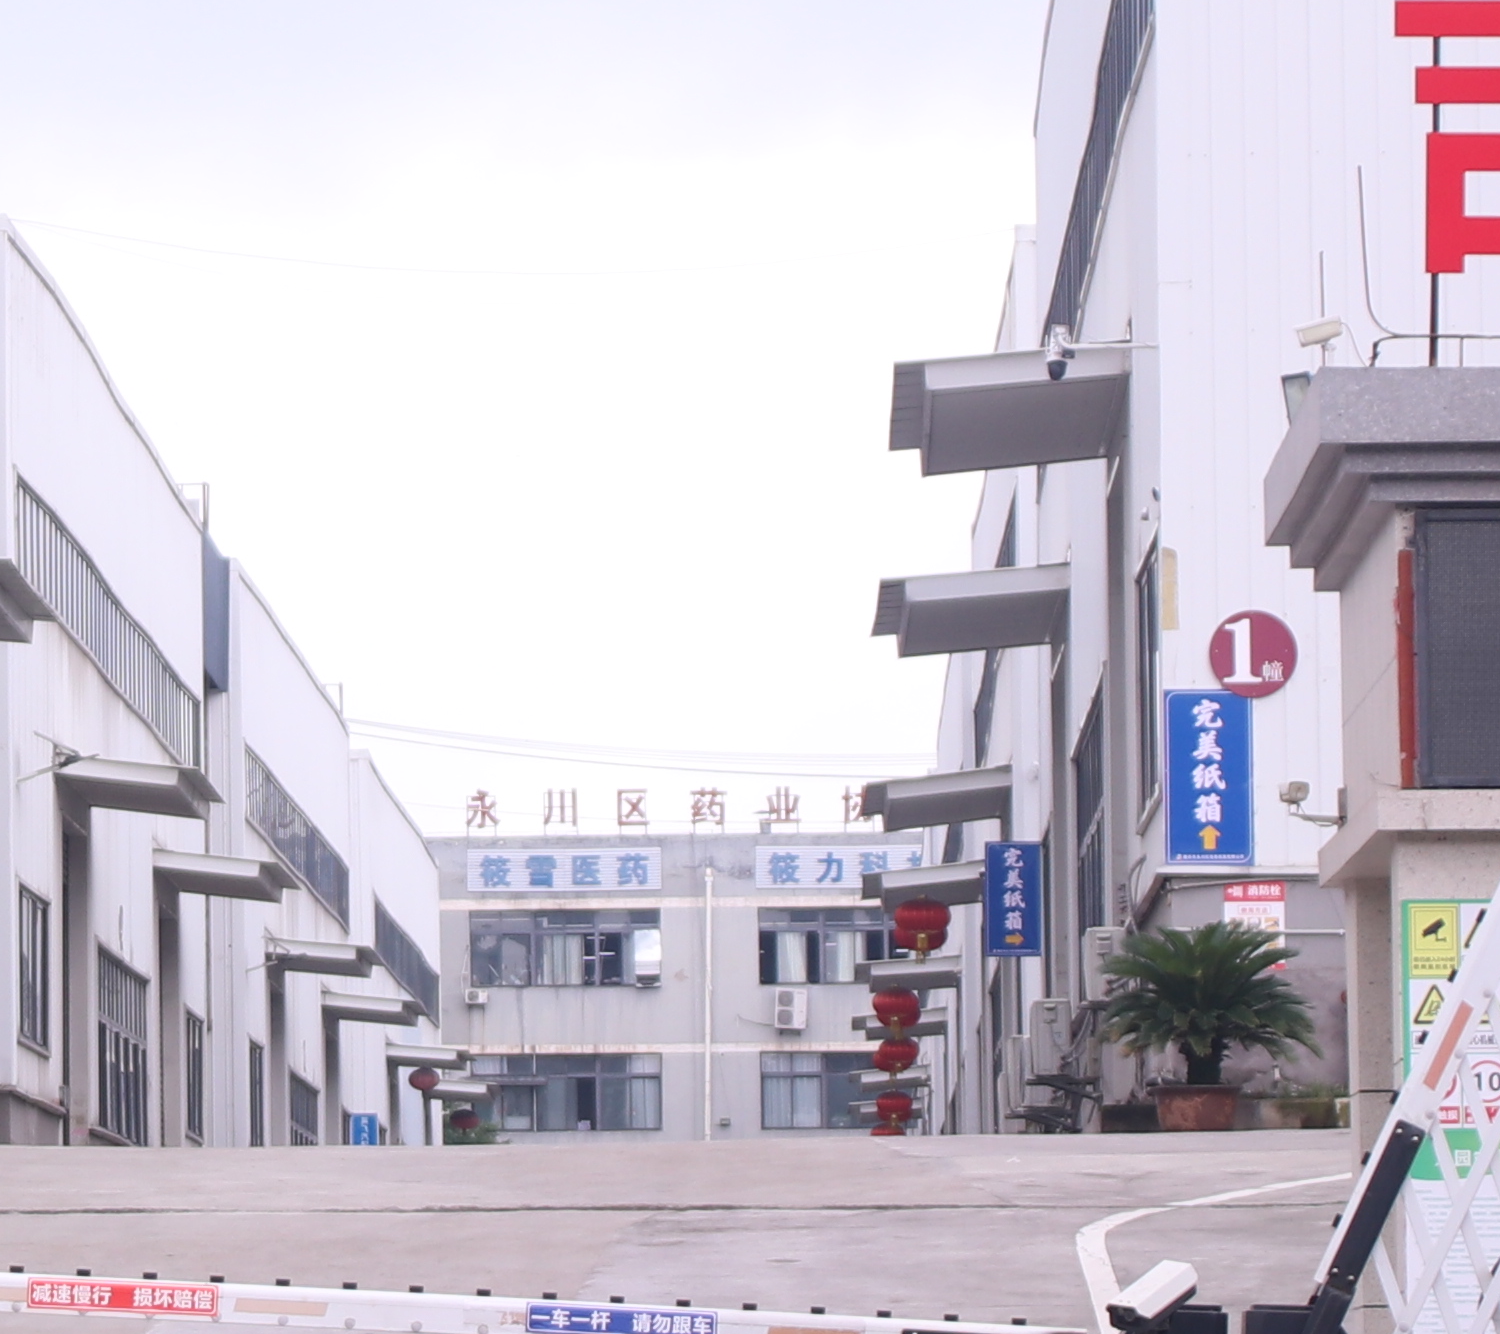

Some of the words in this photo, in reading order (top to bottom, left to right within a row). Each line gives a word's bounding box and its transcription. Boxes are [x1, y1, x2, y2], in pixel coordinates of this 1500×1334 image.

[1191, 698, 1227, 824] 完美纸箱
[1003, 847, 1026, 931] 完美纸箱
[1247, 884, 1281, 897] 消防栓
[32, 1283, 113, 1306] 减速慢行
[132, 1286, 213, 1310] 损坏赔偿
[531, 1308, 611, 1330] 一车一杆
